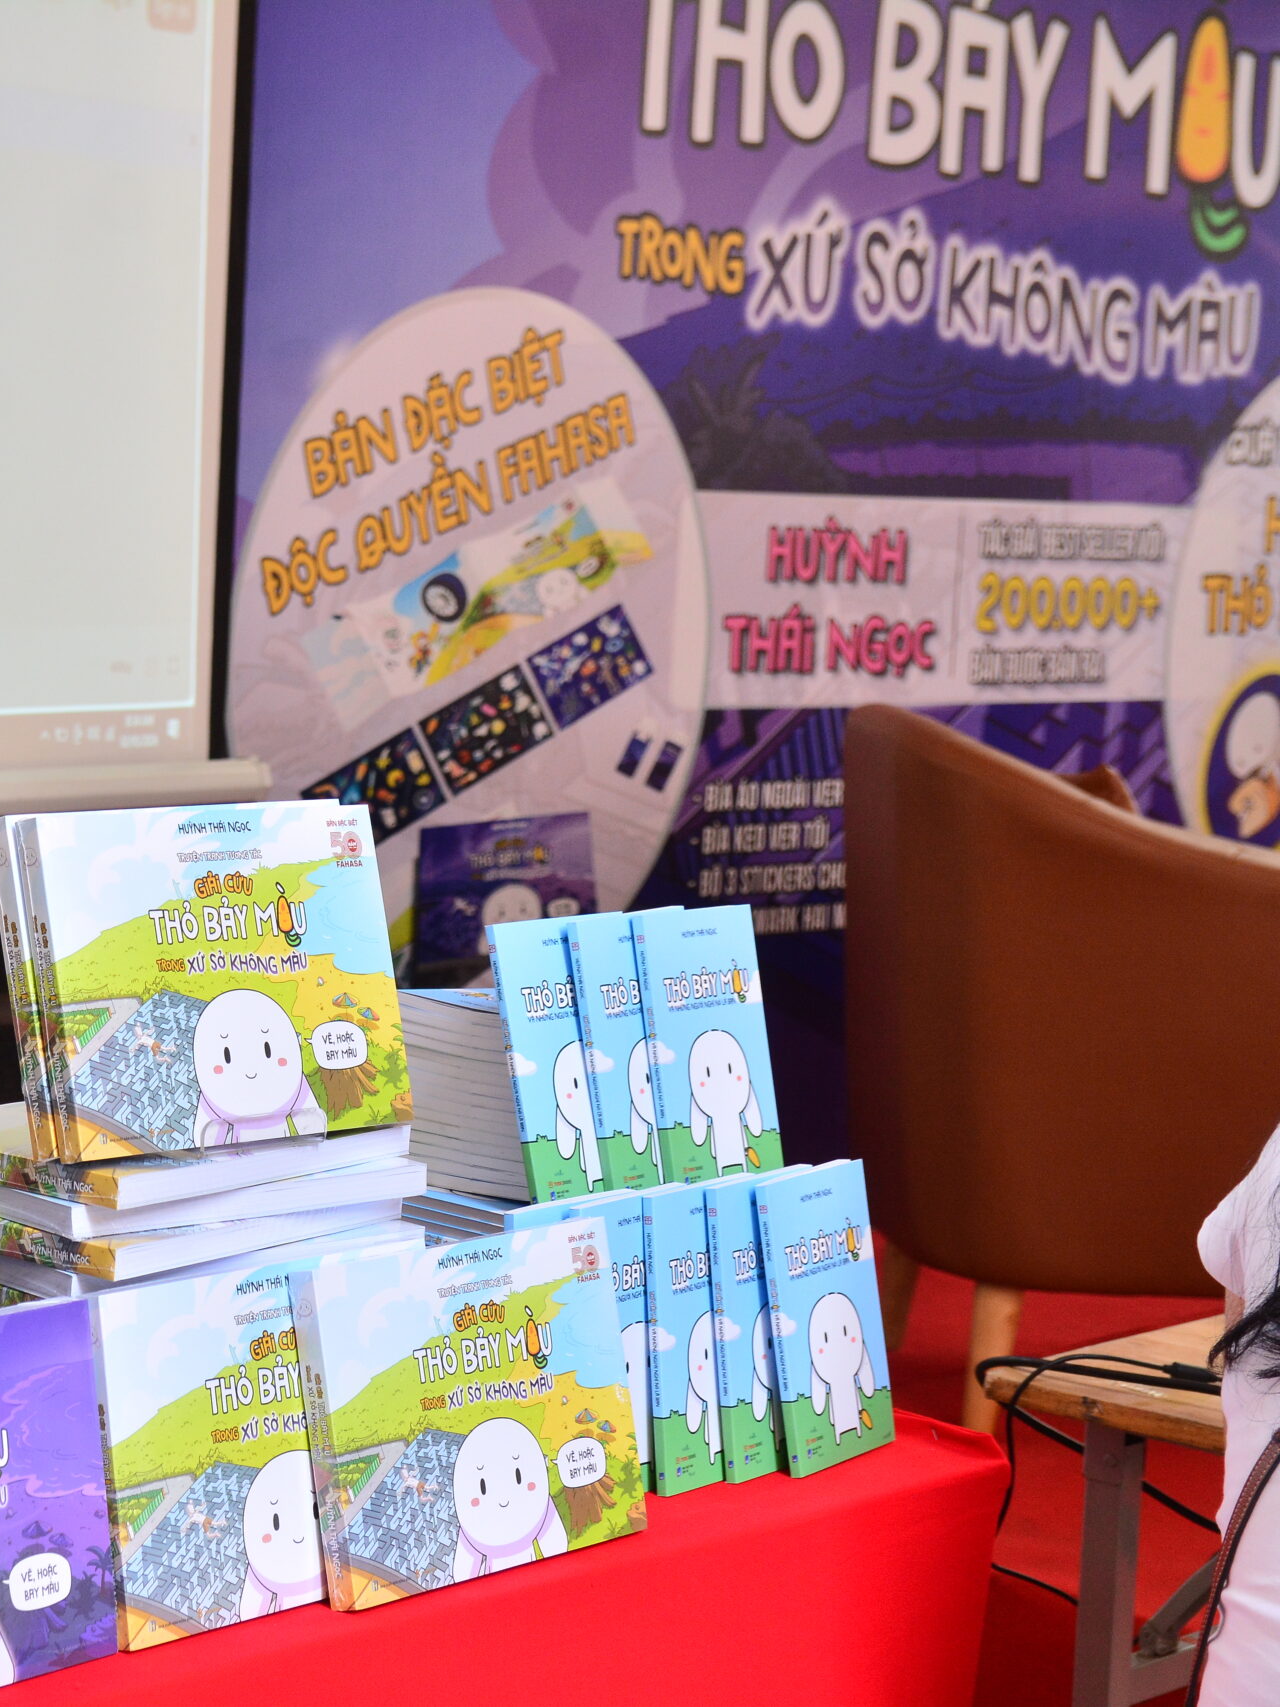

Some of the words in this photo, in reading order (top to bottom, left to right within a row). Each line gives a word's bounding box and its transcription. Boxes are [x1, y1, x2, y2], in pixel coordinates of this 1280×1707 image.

[615, 211, 746, 296] TRONG
[751, 206, 845, 325] XỨ
[857, 212, 931, 322] SỞ
[941, 240, 1137, 379] KHÔNG
[1148, 274, 1258, 379] MÀU
[304, 406, 399, 498] BẢN
[402, 370, 481, 451] ĐẶC
[486, 327, 565, 415] BIỆT
[260, 536, 348, 616] ĐỘC
[497, 393, 635, 503] FAHASA
[766, 515, 909, 585] HUỲNH
[975, 571, 1161, 634] 200.000+
[826, 614, 936, 678] NGỌC
[178, 821, 207, 835] HUỲNH
[336, 859, 363, 868] FAHASA
[224, 871, 253, 896] CỨU
[148, 900, 199, 944] THỎ
[202, 895, 248, 942] BẢY
[156, 957, 185, 972] TRONG
[187, 950, 206, 975] XỨ
[209, 950, 226, 971] SỞ
[230, 951, 278, 974] KHÔNG
[280, 948, 308, 972] MÀU
[600, 977, 629, 1010] THỎ
[663, 971, 690, 1003] THỎ
[691, 966, 717, 999] BẢY
[341, 1045, 358, 1058] MÀU
[33, 1174, 57, 1187] HUỲNH
[437, 1254, 464, 1270] HUỲNH
[669, 1250, 694, 1286] THỎ
[784, 1237, 808, 1273] THỎ
[810, 1230, 834, 1265] BẢY
[576, 1272, 601, 1284] FAHASA
[479, 1299, 505, 1324] CỨU
[413, 1336, 458, 1384] THỎ
[461, 1326, 501, 1374] BẢY
[204, 1365, 254, 1416] THỎ
[420, 1395, 446, 1411] TRONG
[447, 1385, 463, 1411] XỨ
[467, 1381, 483, 1404] SỞ
[484, 1378, 528, 1401] KHÔNG
[529, 1372, 554, 1396] MÀU
[211, 1426, 240, 1444] TRONG
[241, 1416, 260, 1443] XỨ
[263, 1412, 280, 1433] SỞ
[41, 1580, 60, 1597] MÀU
